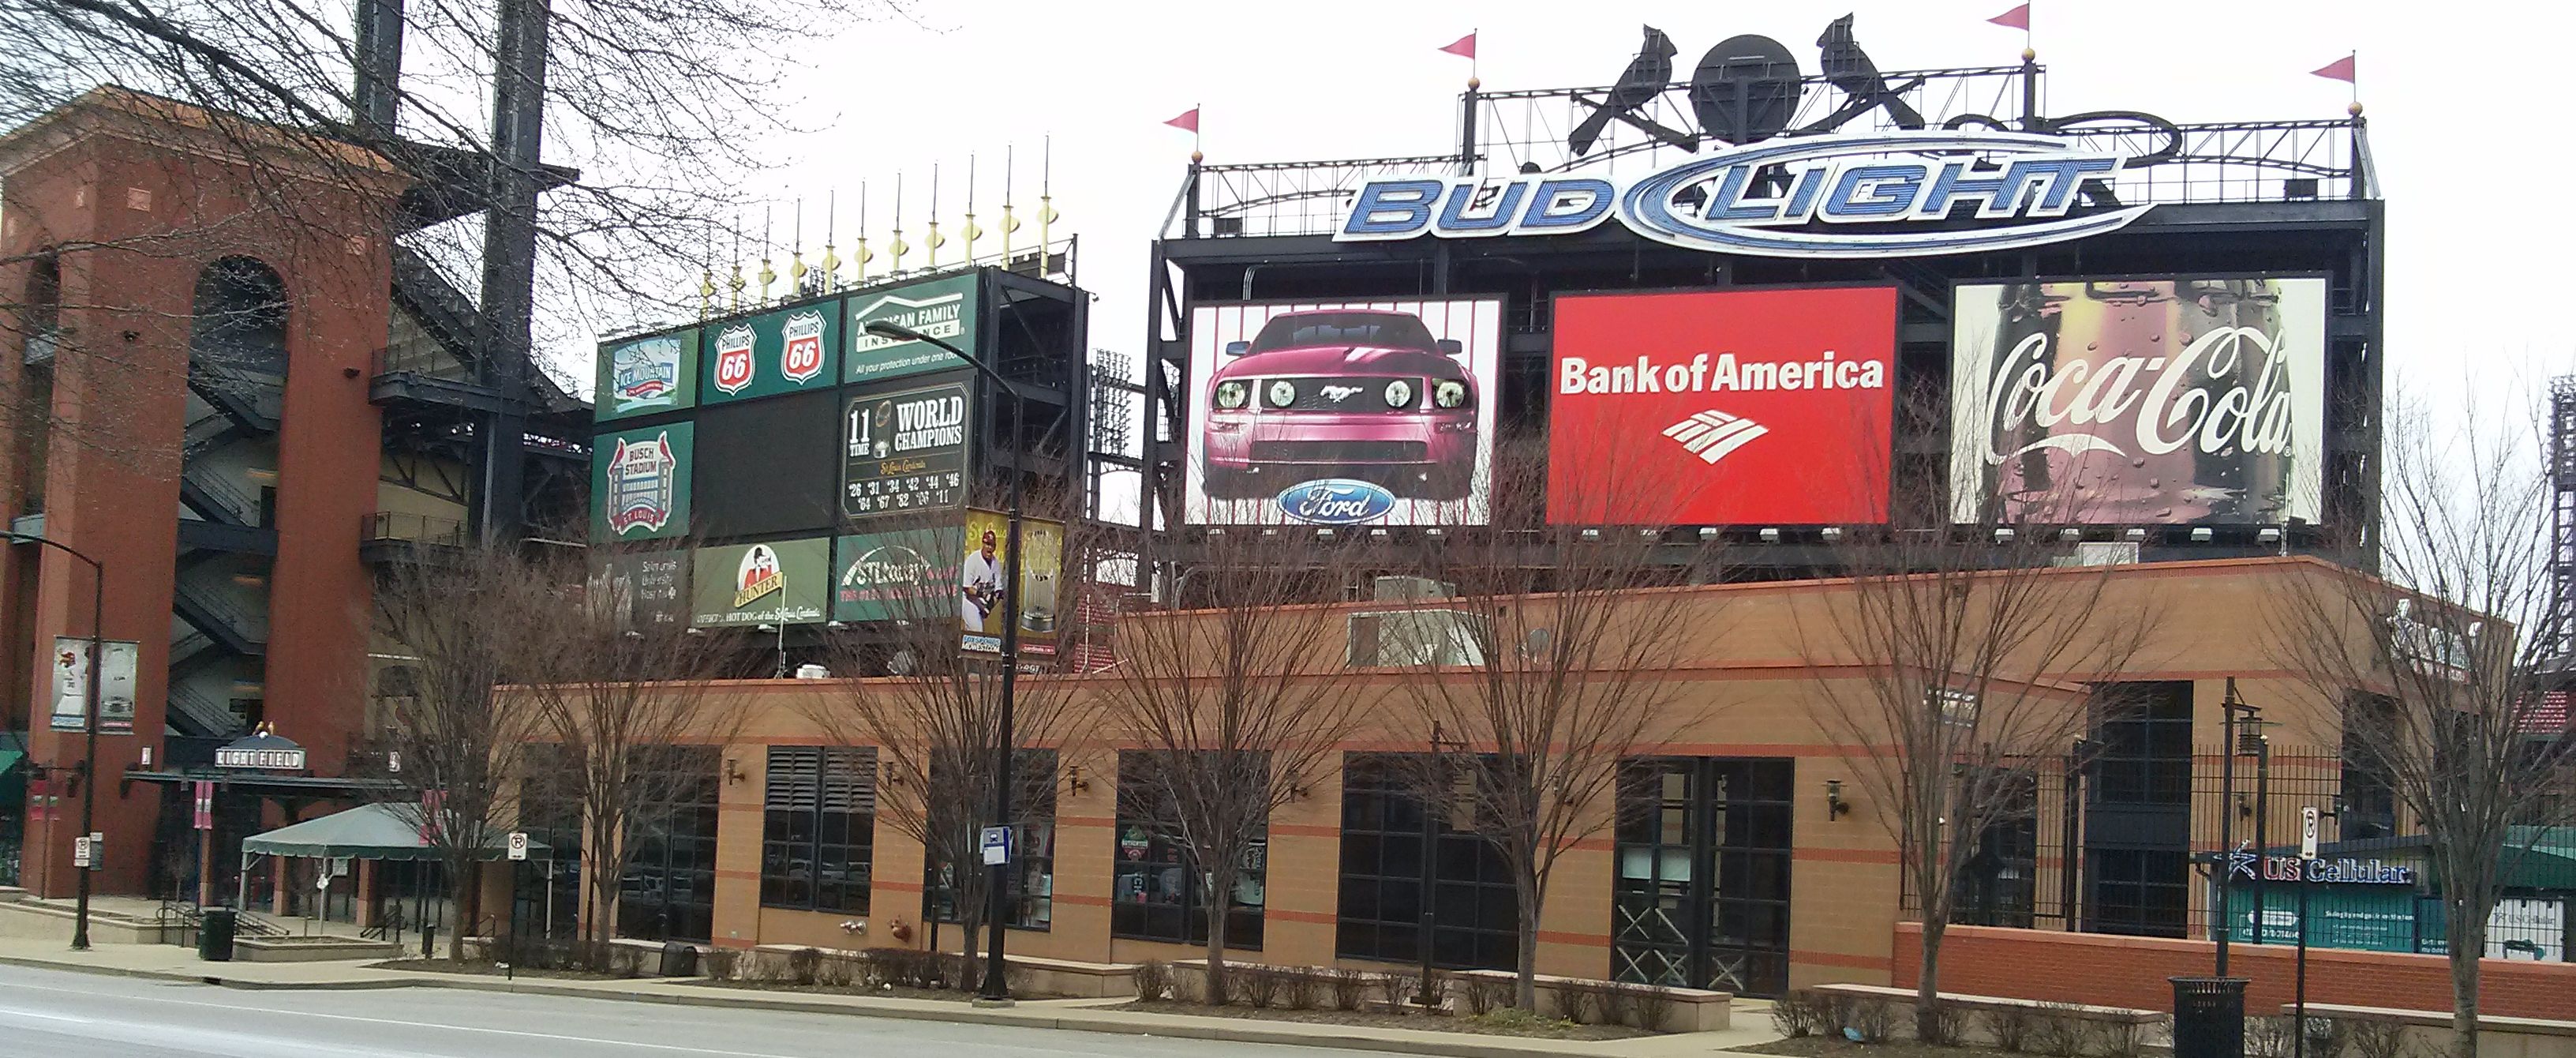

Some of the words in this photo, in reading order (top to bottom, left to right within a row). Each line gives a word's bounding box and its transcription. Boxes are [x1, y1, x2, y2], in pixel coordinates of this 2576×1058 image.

[1334, 174, 1618, 242] BUD
[1702, 152, 2129, 227] LIGHT
[919, 304, 961, 325] FAMILY
[789, 321, 819, 338] PHILLIPS
[721, 334, 750, 351] PHILLIPS
[721, 353, 747, 381] 66
[789, 341, 817, 370] 66
[856, 365, 865, 374] All
[865, 362, 880, 375] your
[879, 357, 911, 372] protection
[912, 353, 930, 366] under
[931, 353, 944, 362] one
[620, 371, 631, 386] ICE
[633, 366, 672, 382] MOUNTAIN
[1560, 355, 1661, 395] Bank
[1664, 352, 1709, 392] of
[1710, 350, 1883, 392] America
[1985, 325, 2293, 466] Coca-Cola
[897, 396, 964, 433] WORLD
[850, 409, 870, 444] 11
[850, 443, 870, 457] TIME
[894, 425, 962, 452] CHAMPIONS
[629, 448, 654, 462] BUSCH
[625, 460, 657, 475] STADIUM
[867, 481, 880, 496] '31
[886, 478, 900, 493] '34
[906, 477, 919, 491] '42
[925, 475, 938, 489] '44
[946, 472, 960, 487] '46
[877, 494, 890, 509] '67
[897, 493, 909, 508] '82
[1299, 484, 1371, 517] Ford
[635, 510, 654, 523] LOUIS
[739, 574, 778, 605] HUNTER
[726, 612, 741, 622] HOT
[741, 611, 757, 622] DOG
[758, 611, 765, 621] of
[765, 610, 774, 620] the
[217, 750, 254, 765] RIGHT
[260, 751, 299, 767] FIELD
[2263, 857, 2302, 882] US
